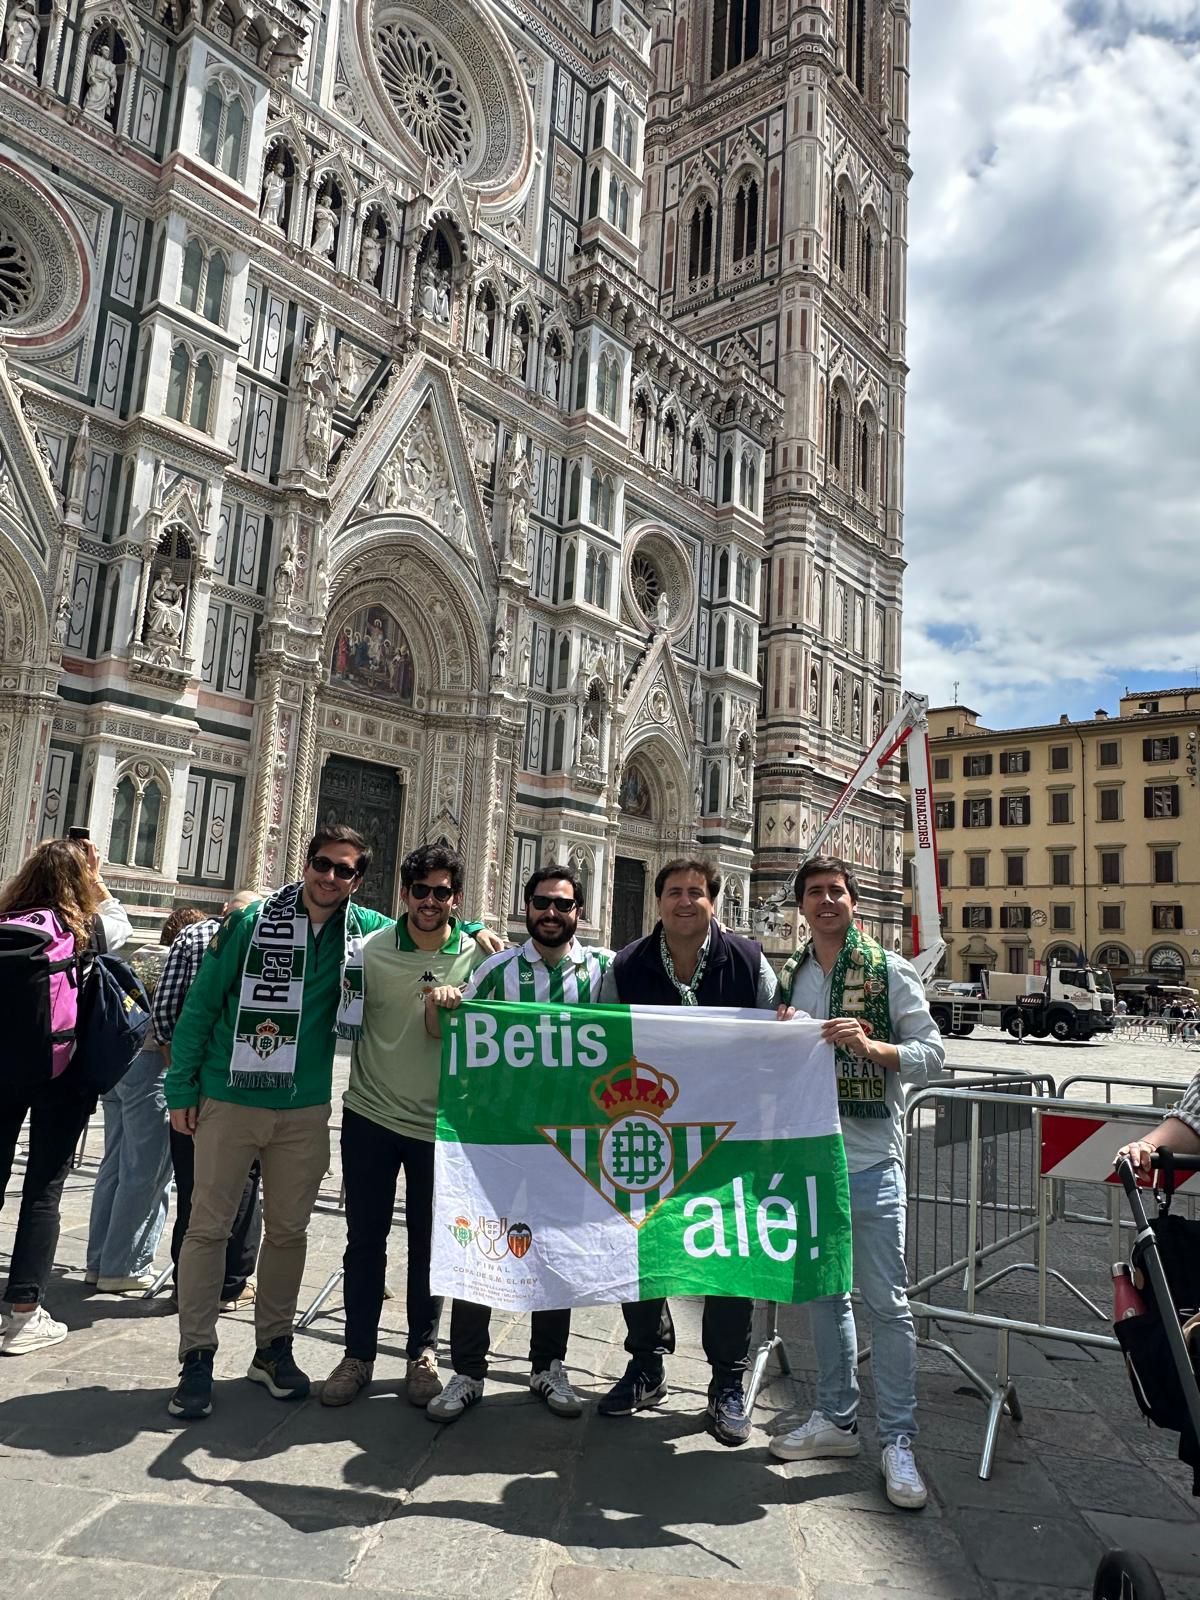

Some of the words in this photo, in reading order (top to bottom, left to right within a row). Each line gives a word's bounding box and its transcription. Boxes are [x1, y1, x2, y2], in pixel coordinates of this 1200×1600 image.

[915, 788, 930, 848] BONACCORSO
[252, 945, 294, 1001] Real
[449, 1011, 608, 1076] ¡Betis
[838, 1078, 883, 1098] BETIS
[842, 1062, 879, 1078] REAL
[683, 1173, 819, 1263] alé!
[453, 1266, 475, 1276] COPA
[476, 1261, 510, 1273] FINAL
